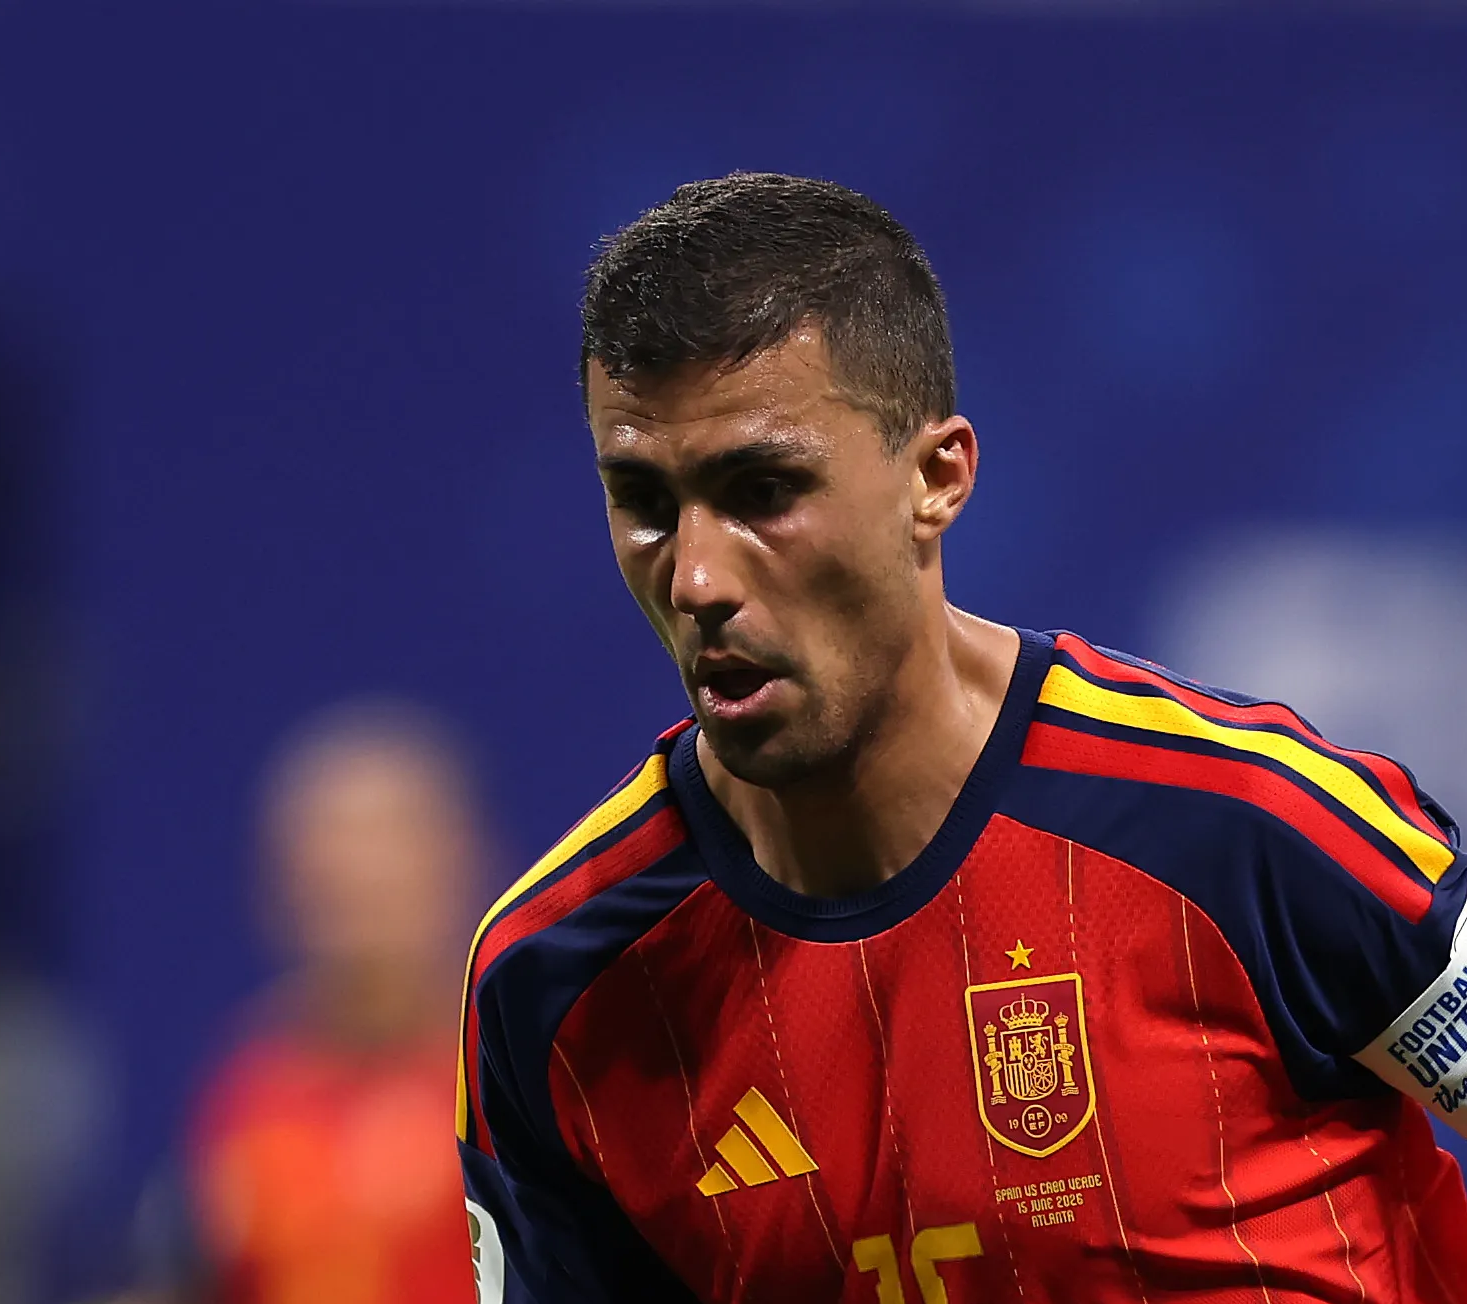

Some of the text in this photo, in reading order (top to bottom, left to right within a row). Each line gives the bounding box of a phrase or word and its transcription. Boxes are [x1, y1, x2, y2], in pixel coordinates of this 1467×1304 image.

[1008, 1118, 1019, 1130] 19
[995, 1186, 1023, 1202] SPAIN
[1039, 1179, 1067, 1195] CABO
[1068, 1174, 1103, 1191] VERDE
[1016, 1192, 1084, 1214] 15 JUNE 2026
[1031, 1209, 1075, 1228] ATLANTA
